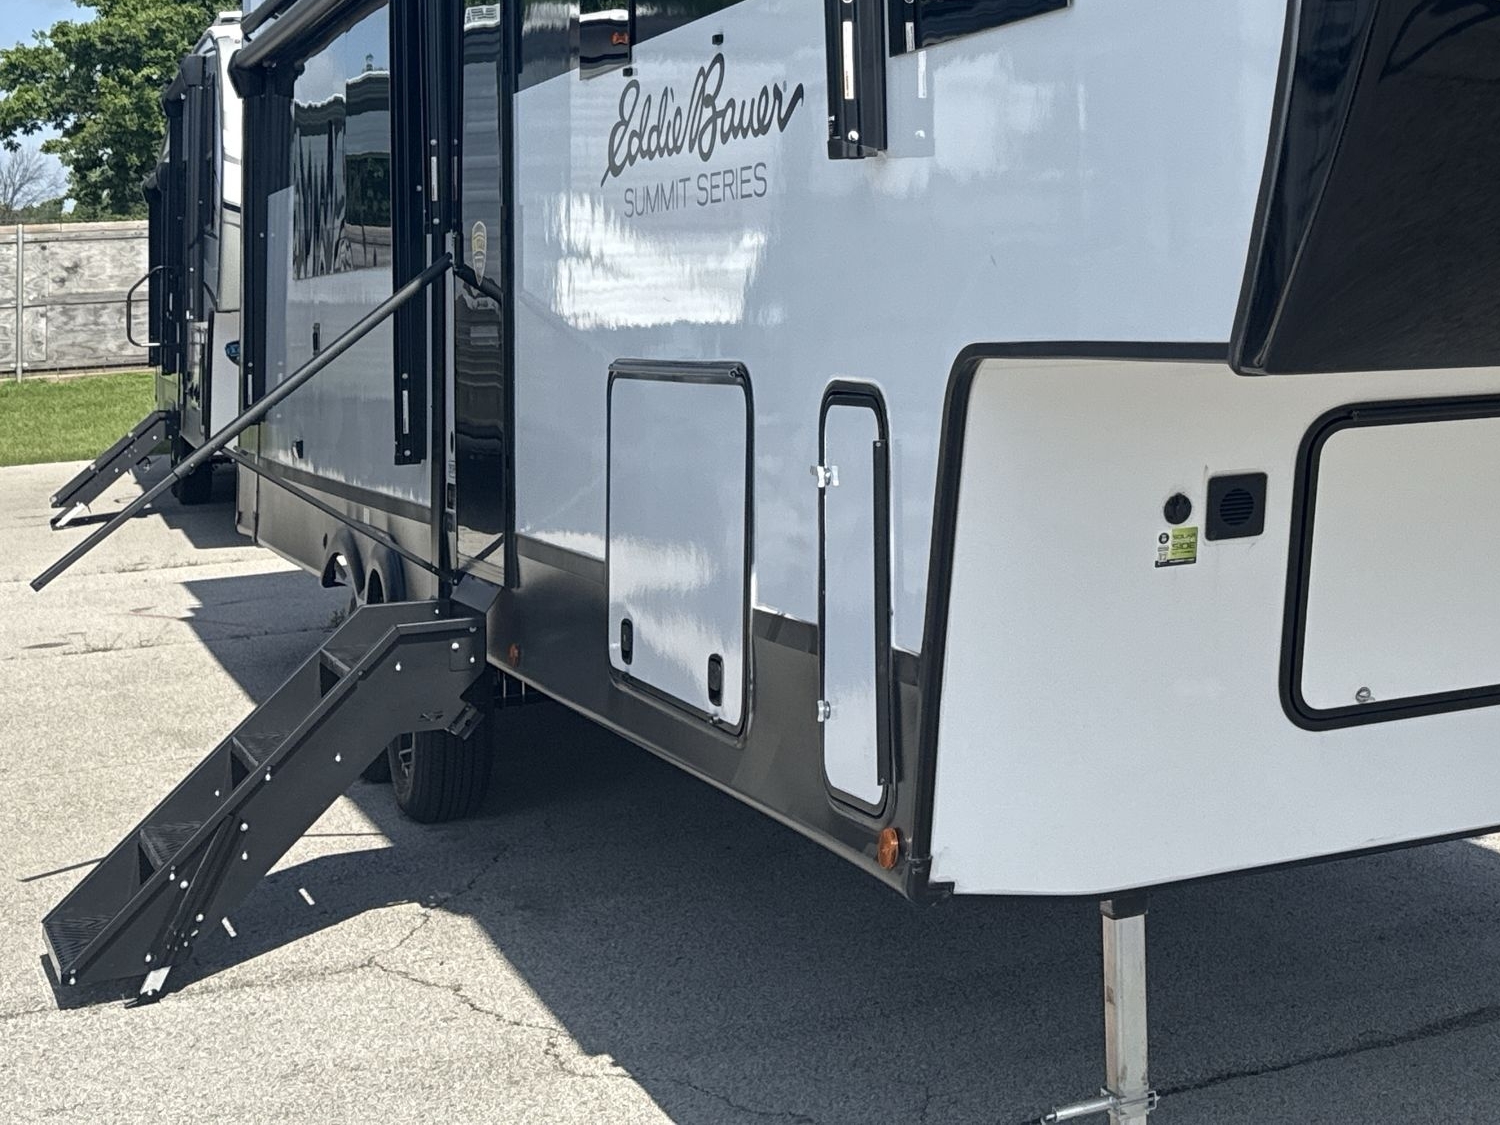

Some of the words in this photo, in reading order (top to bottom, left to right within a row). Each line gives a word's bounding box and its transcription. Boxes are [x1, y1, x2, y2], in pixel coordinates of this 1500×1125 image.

[600, 78, 685, 188] Eddie
[684, 51, 805, 163] Bauer
[623, 176, 691, 219] SUMMIT
[696, 161, 768, 207] SERIES
